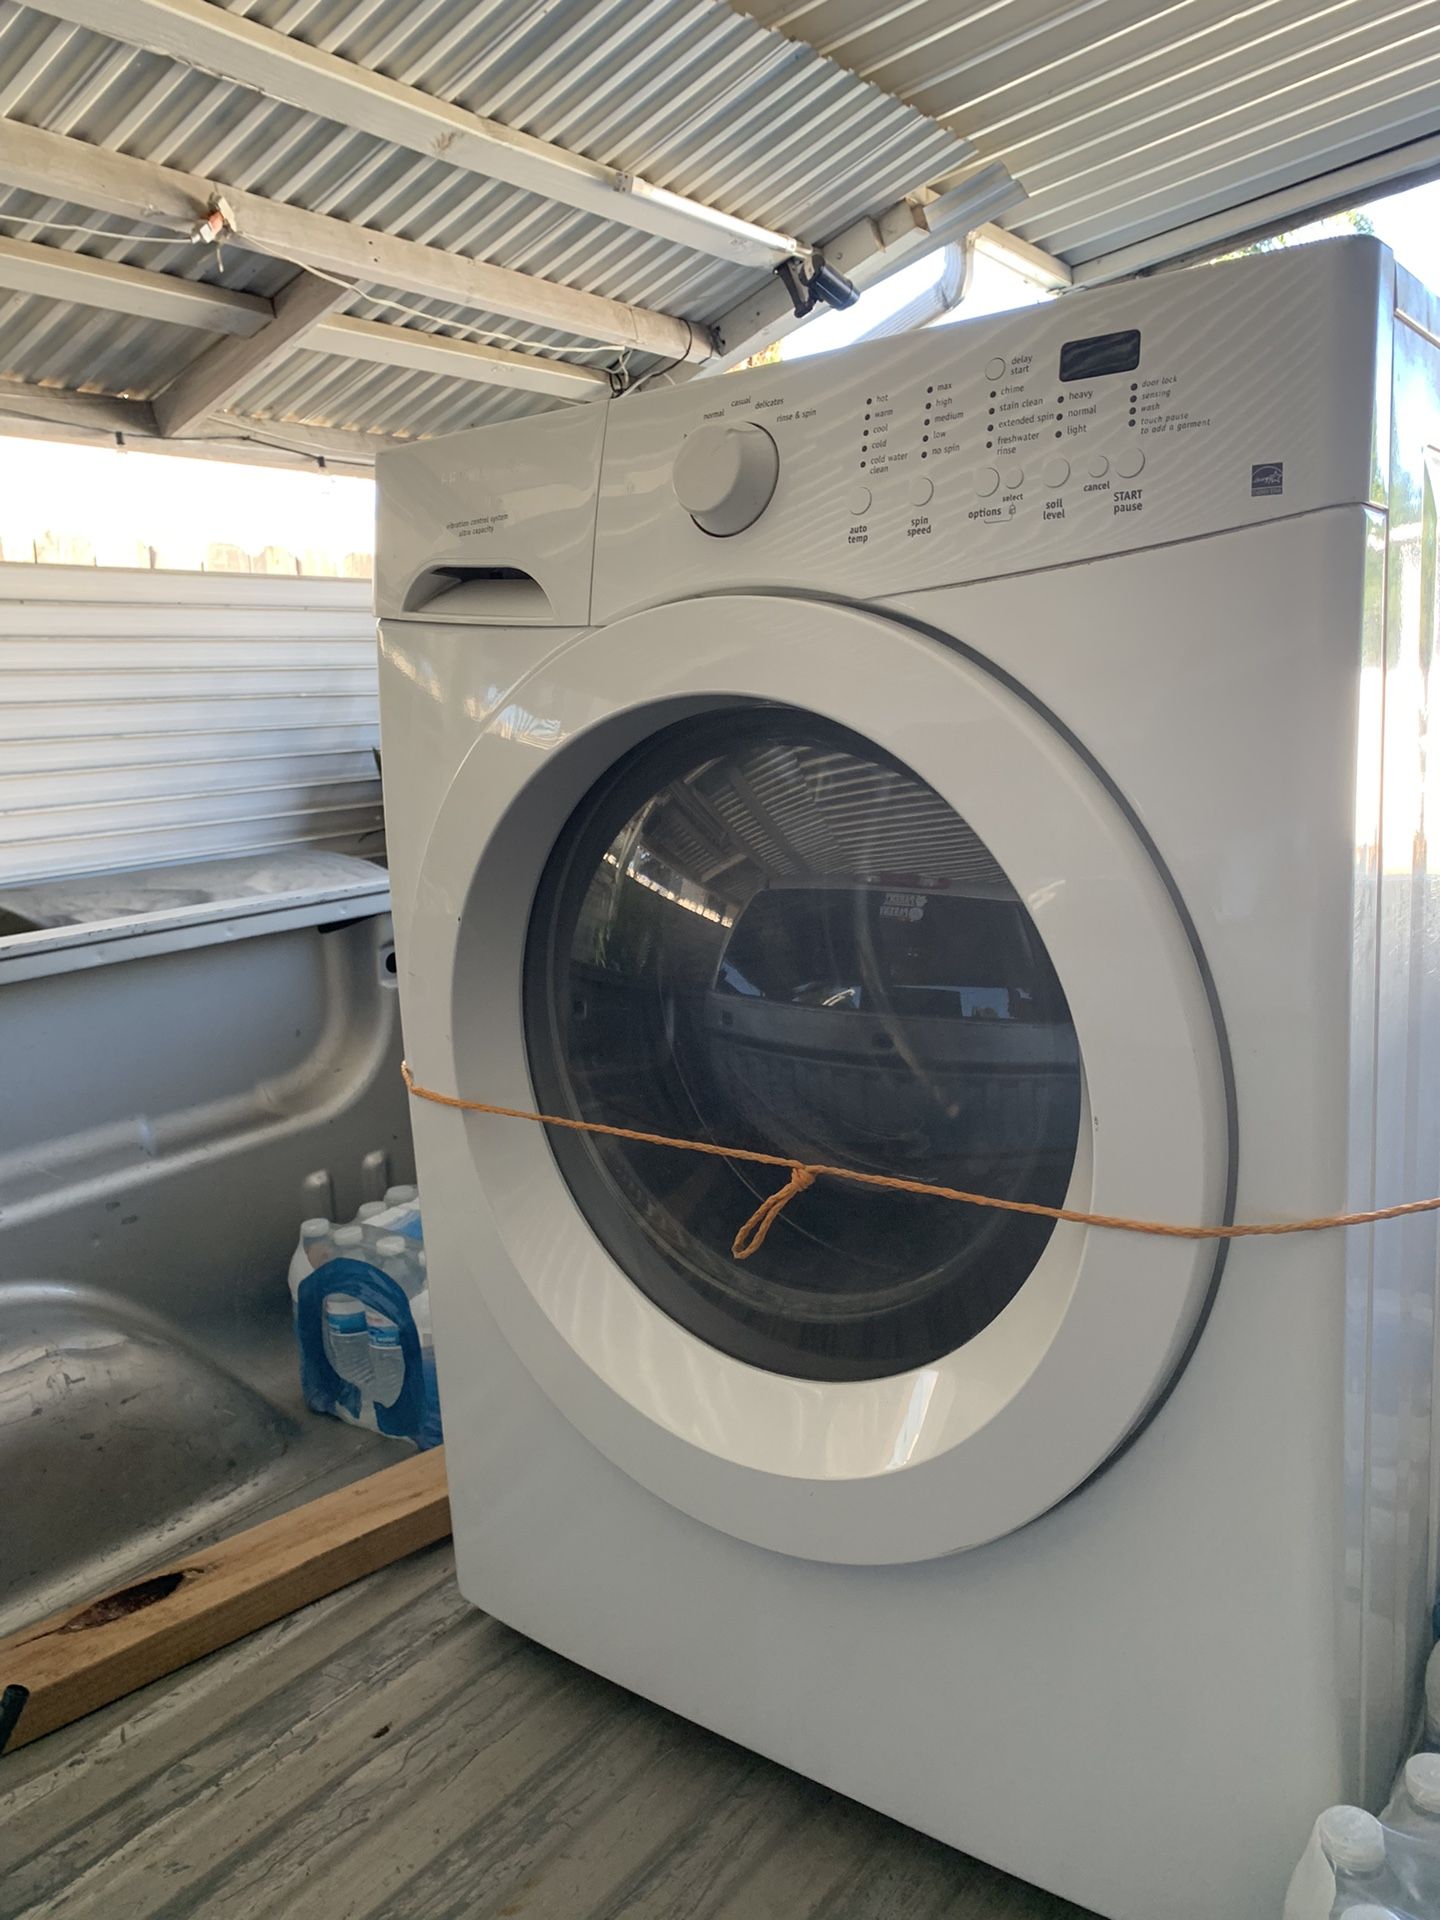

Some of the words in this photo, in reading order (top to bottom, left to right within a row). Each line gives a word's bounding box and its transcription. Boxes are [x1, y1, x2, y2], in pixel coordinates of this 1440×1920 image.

[1011, 355, 1033, 366] delay
[1010, 365, 1030, 375] start
[937, 383, 952, 391] max
[1141, 379, 1160, 388] door
[1161, 375, 1177, 385] lock
[1000, 385, 1025, 396] chime
[1068, 390, 1094, 401] heavy
[1141, 389, 1171, 400] sensing
[730, 396, 752, 407] casual
[754, 397, 784, 410] delicates
[936, 397, 953, 408] high
[999, 402, 1020, 412] stain
[1021, 397, 1044, 408] clean
[1140, 402, 1160, 412] wash
[703, 408, 725, 420] normal
[776, 411, 794, 423] rinse
[794, 410, 801, 420] &
[802, 409, 816, 418] spin
[874, 409, 894, 418] warm
[1067, 405, 1097, 417] normal
[934, 412, 963, 422] medium
[998, 415, 1035, 428] extended
[1036, 411, 1055, 423] spin
[1165, 413, 1189, 423] pause
[872, 424, 889, 434] cool
[1066, 424, 1087, 436] light
[1176, 419, 1210, 432] garment
[933, 431, 946, 440] low
[997, 432, 1040, 445] freshwater
[871, 440, 888, 450] cold
[943, 443, 960, 455] spin
[996, 446, 1017, 456] rinse
[870, 455, 886, 465] cold
[887, 452, 909, 463] water
[869, 465, 889, 475] clean
[1083, 481, 1111, 493] cancel
[1002, 493, 1024, 503] select
[1113, 489, 1143, 502] START
[1045, 498, 1063, 510] soil
[1113, 501, 1143, 516] pause
[968, 507, 1002, 521] options
[1043, 508, 1065, 521] level
[446, 521, 469, 529] vibration
[470, 517, 489, 525] control
[490, 514, 508, 523] system
[911, 515, 929, 528] spin
[472, 526, 494, 535] capacity
[849, 525, 868, 535] auto
[907, 525, 932, 538] speed
[847, 535, 869, 545] temp
